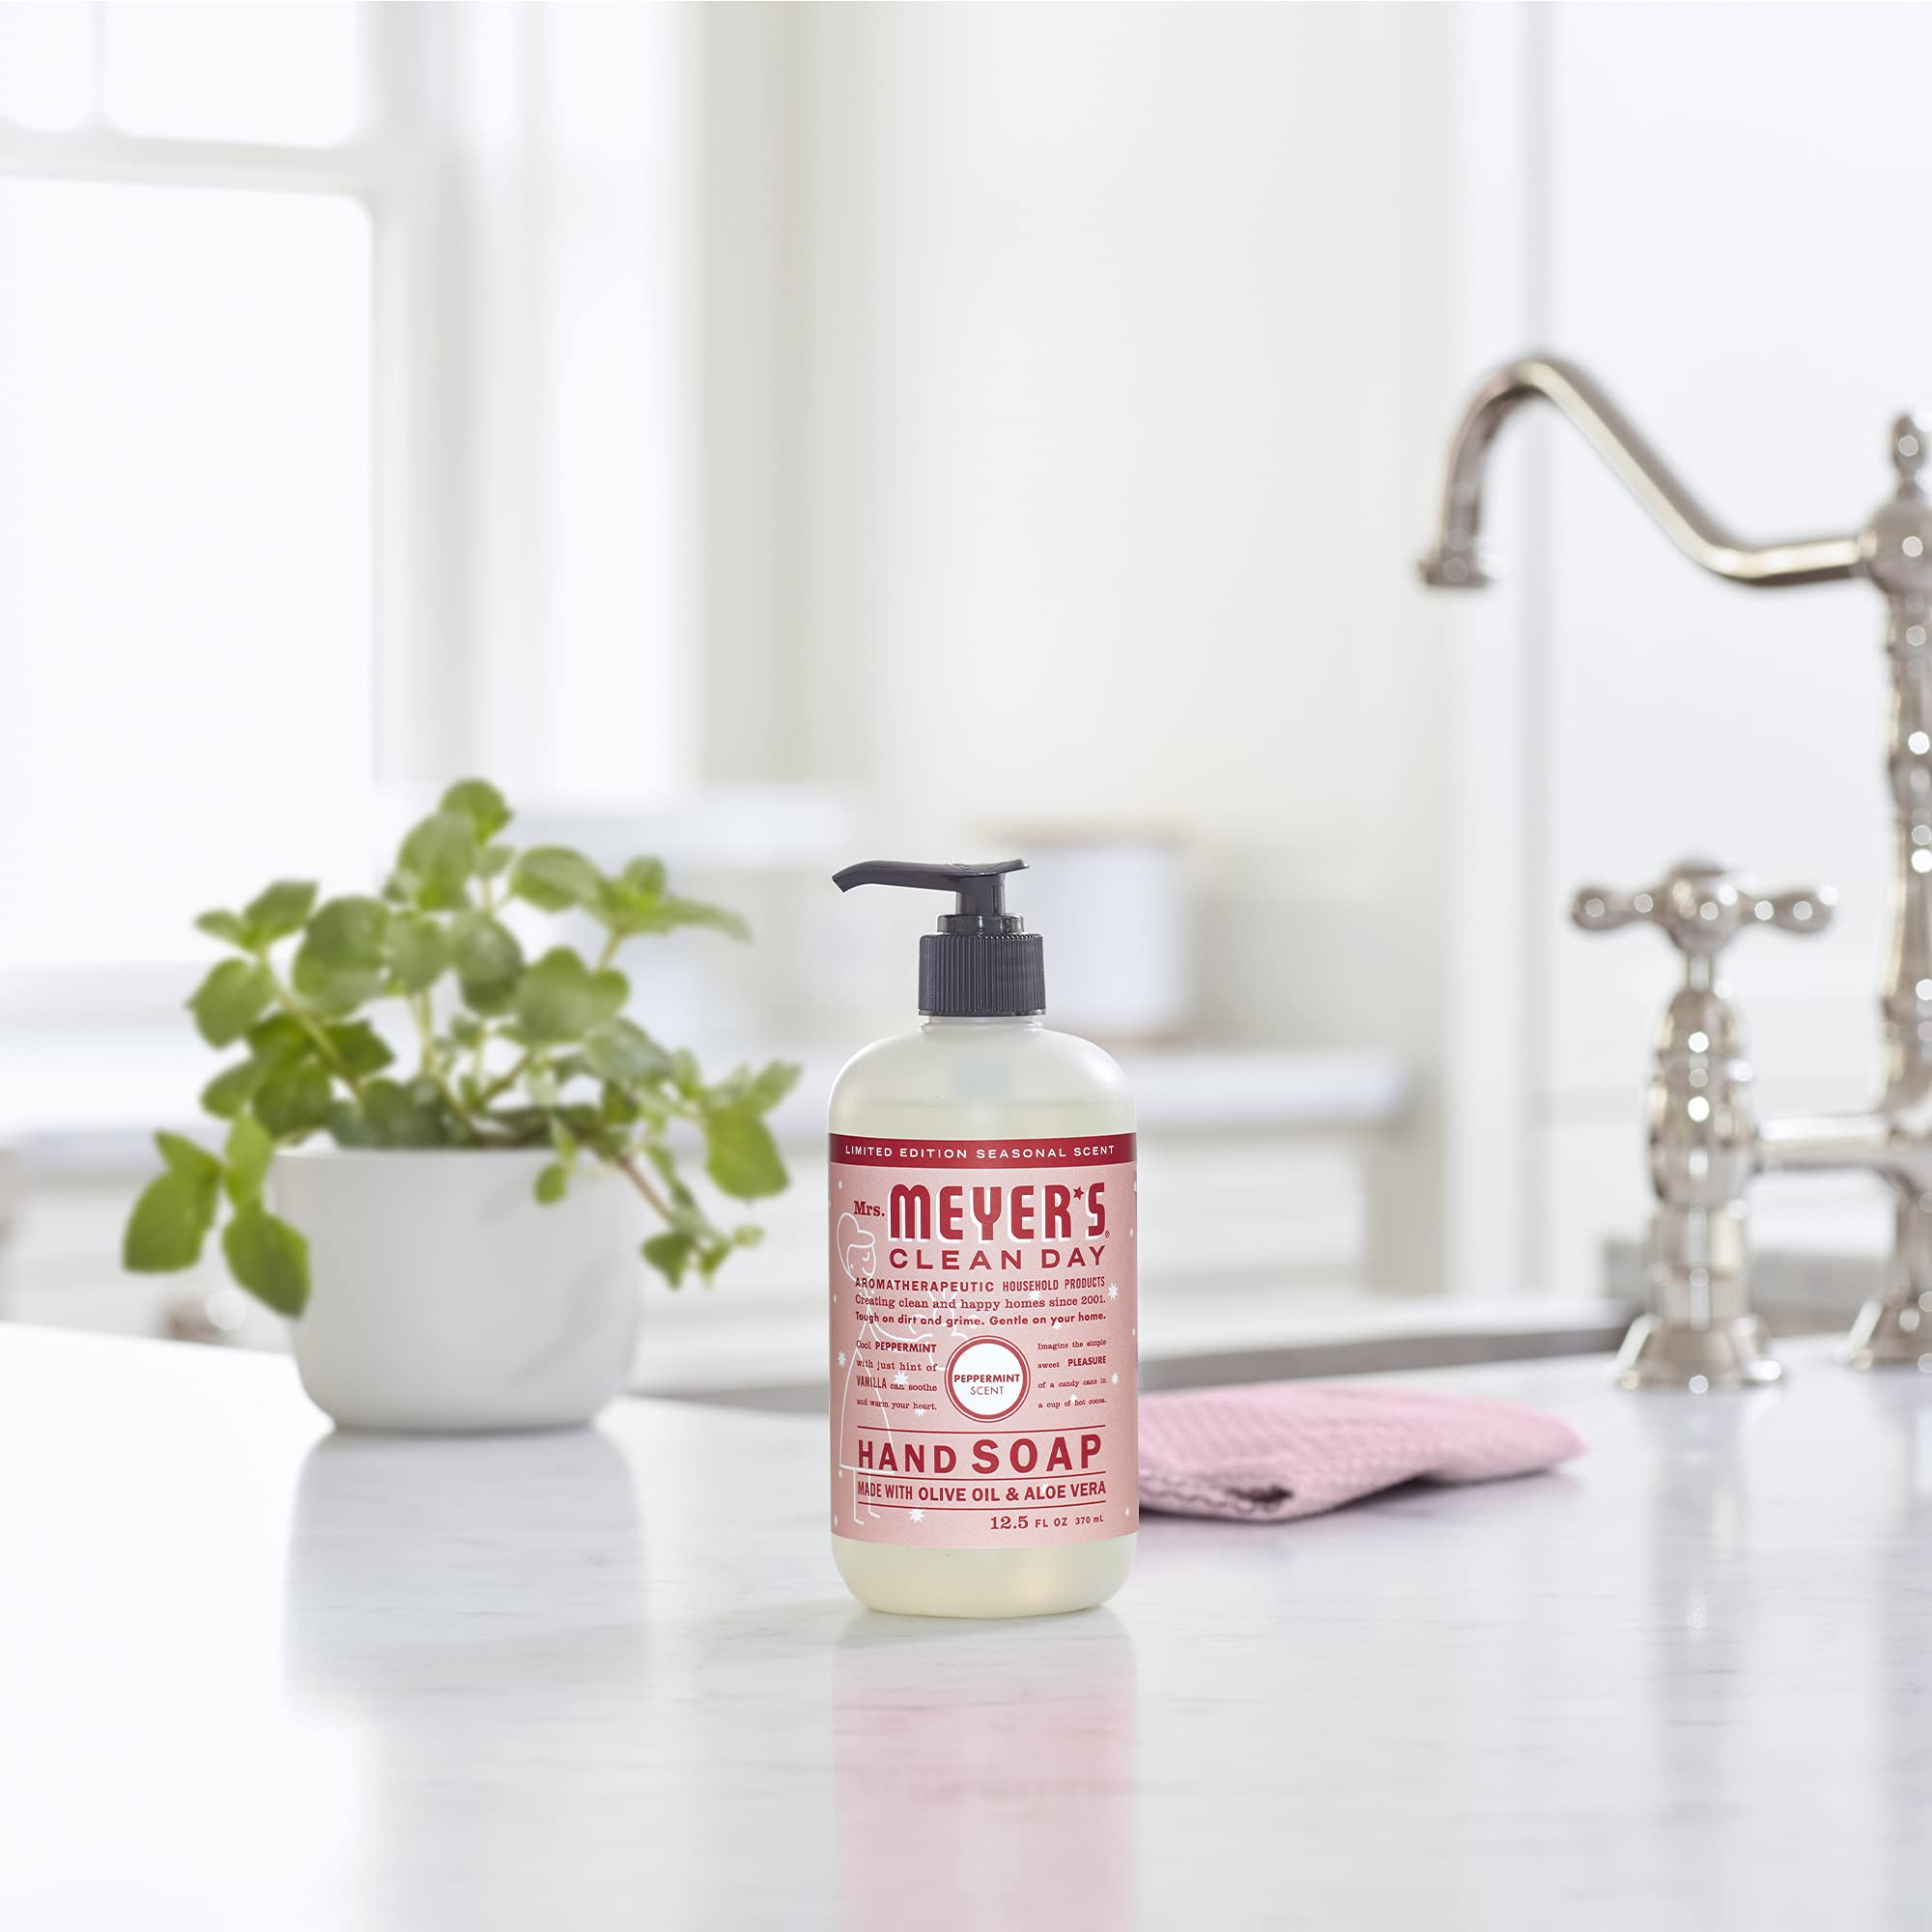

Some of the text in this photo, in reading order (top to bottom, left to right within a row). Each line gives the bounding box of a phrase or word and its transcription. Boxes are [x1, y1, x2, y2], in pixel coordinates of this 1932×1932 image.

[845, 1145, 1115, 1158] LIMITED EDITION SEASONAL SCENT
[854, 1201, 885, 1216] Mrs.
[890, 1245, 1105, 1270] CLEAN DAY
[855, 1276, 1105, 1293] AROMATHERAPEUTIC HOUSEHOLD PRODUCTS
[855, 1294, 1106, 1311] Creating clean and happy homes since 2001.
[855, 1312, 1106, 1327] Tough on dirt and grime. Gentle on your home.
[856, 1340, 936, 1352] Cool PEPPERMINT
[1037, 1342, 1068, 1350] Imagine
[877, 1361, 895, 1371] just
[1068, 1356, 1106, 1367] PLEASURE
[857, 1376, 887, 1389] VANILLA
[953, 1374, 1020, 1384] PEPPERMINT
[970, 1386, 1004, 1395] SCENT
[858, 1434, 1101, 1474] HAND SOAP
[858, 1481, 1106, 1502] MADE WITH OLIVE OIL & ALOE VERA
[990, 1515, 1103, 1530] 12.5 FL OZ 370 mL
